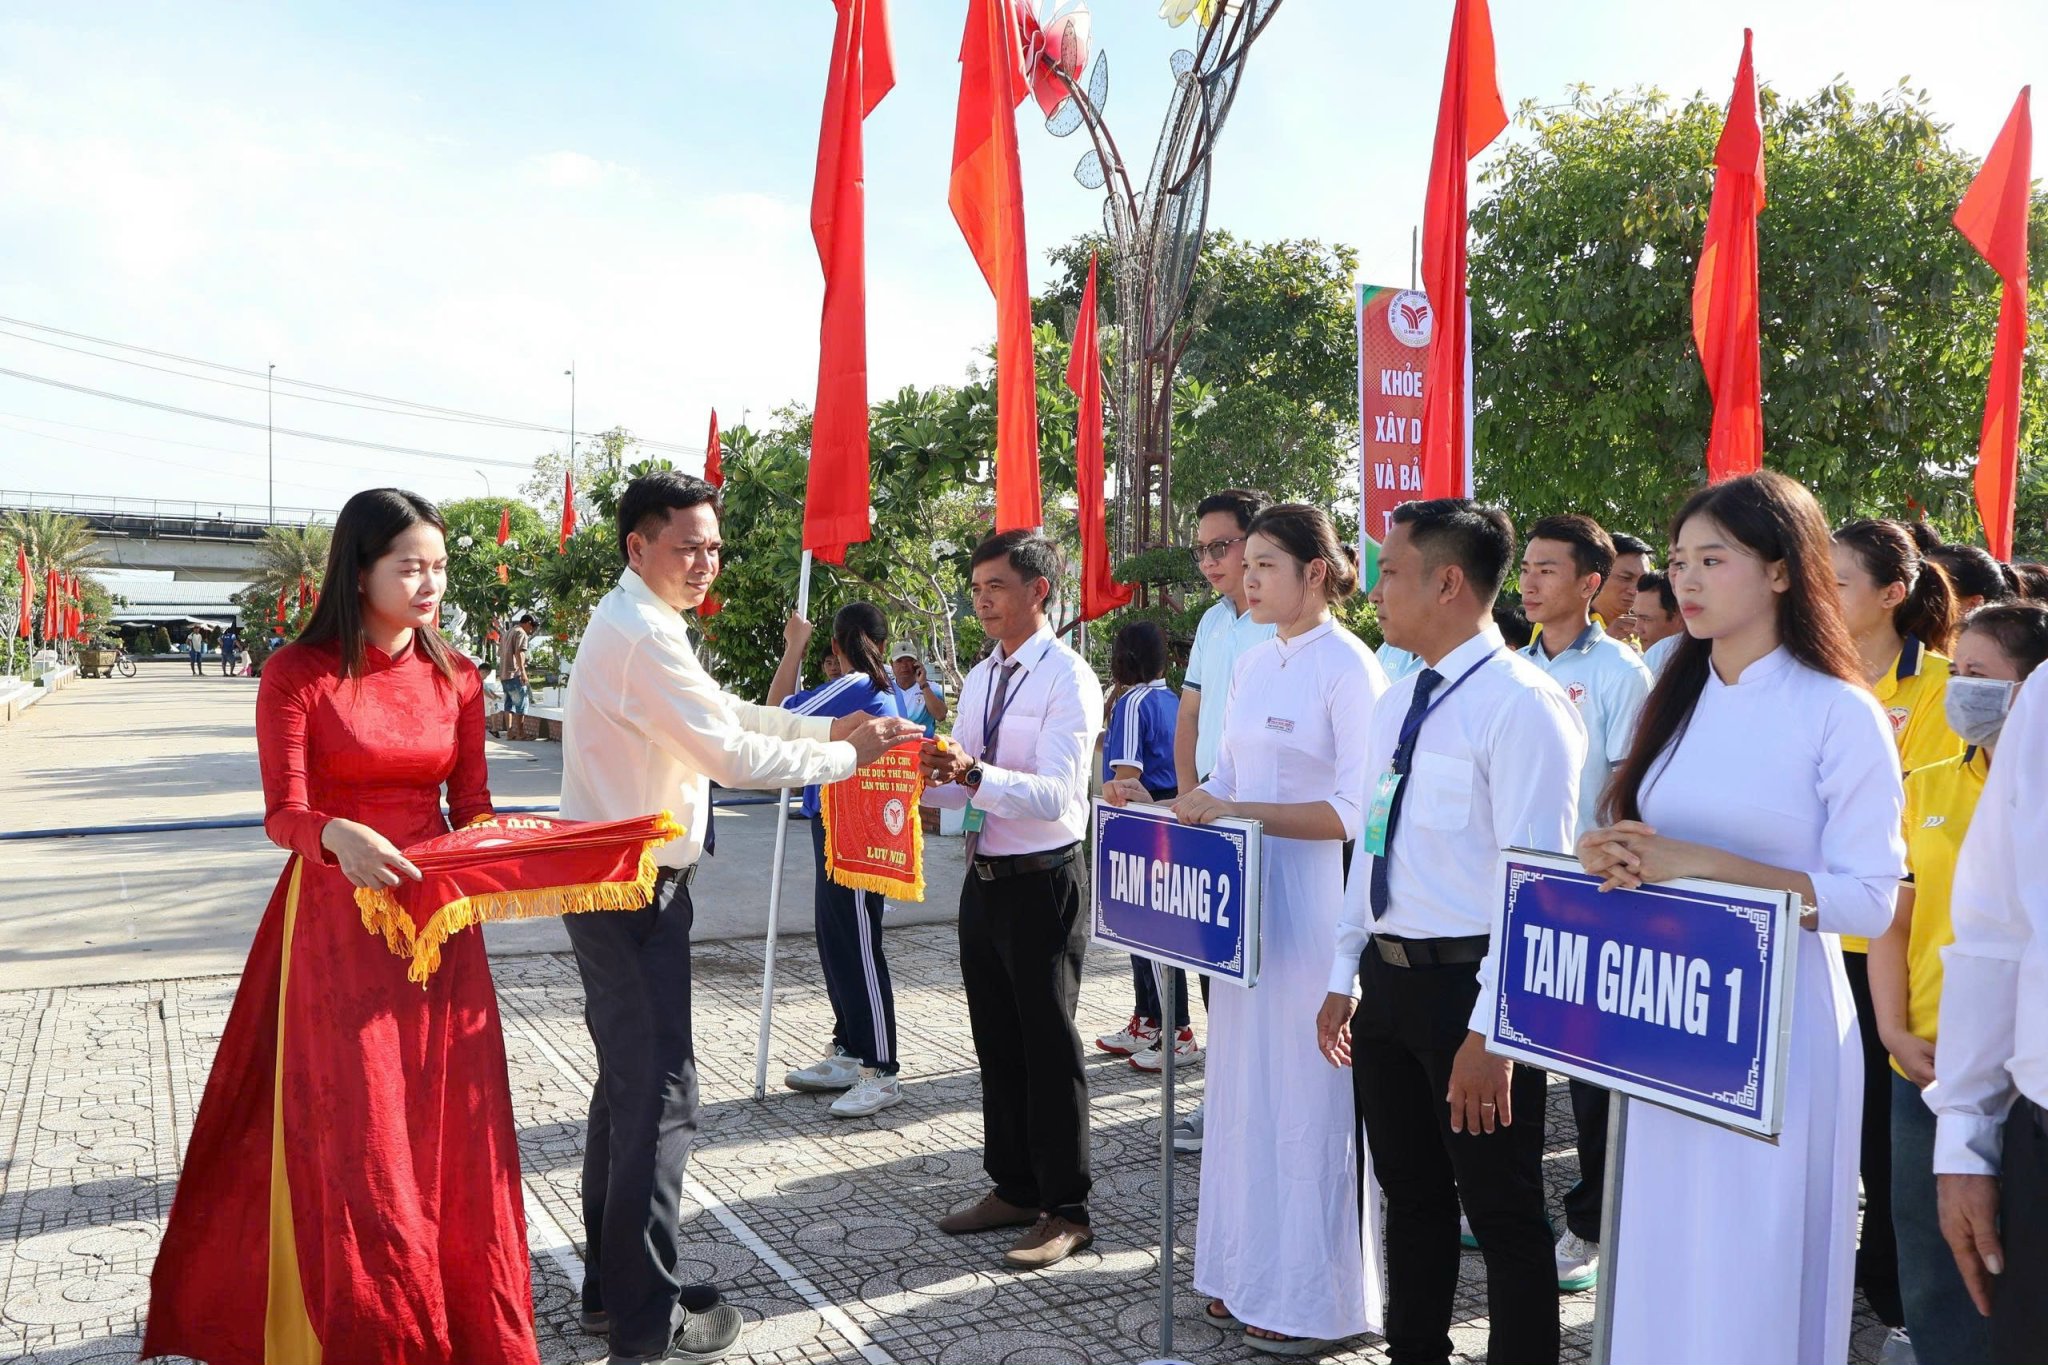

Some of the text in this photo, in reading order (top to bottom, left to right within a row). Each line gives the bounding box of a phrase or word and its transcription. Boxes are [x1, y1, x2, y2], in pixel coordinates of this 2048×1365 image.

[1381, 361, 1423, 398] KHỎE
[1375, 411, 1406, 444] XÂY
[1374, 457, 1424, 491] VÀ BẢ
[872, 768, 886, 780] DỤC
[1109, 849, 1231, 928] TAM GIANG 2
[1523, 923, 1743, 1044] TAM GIANG 1
